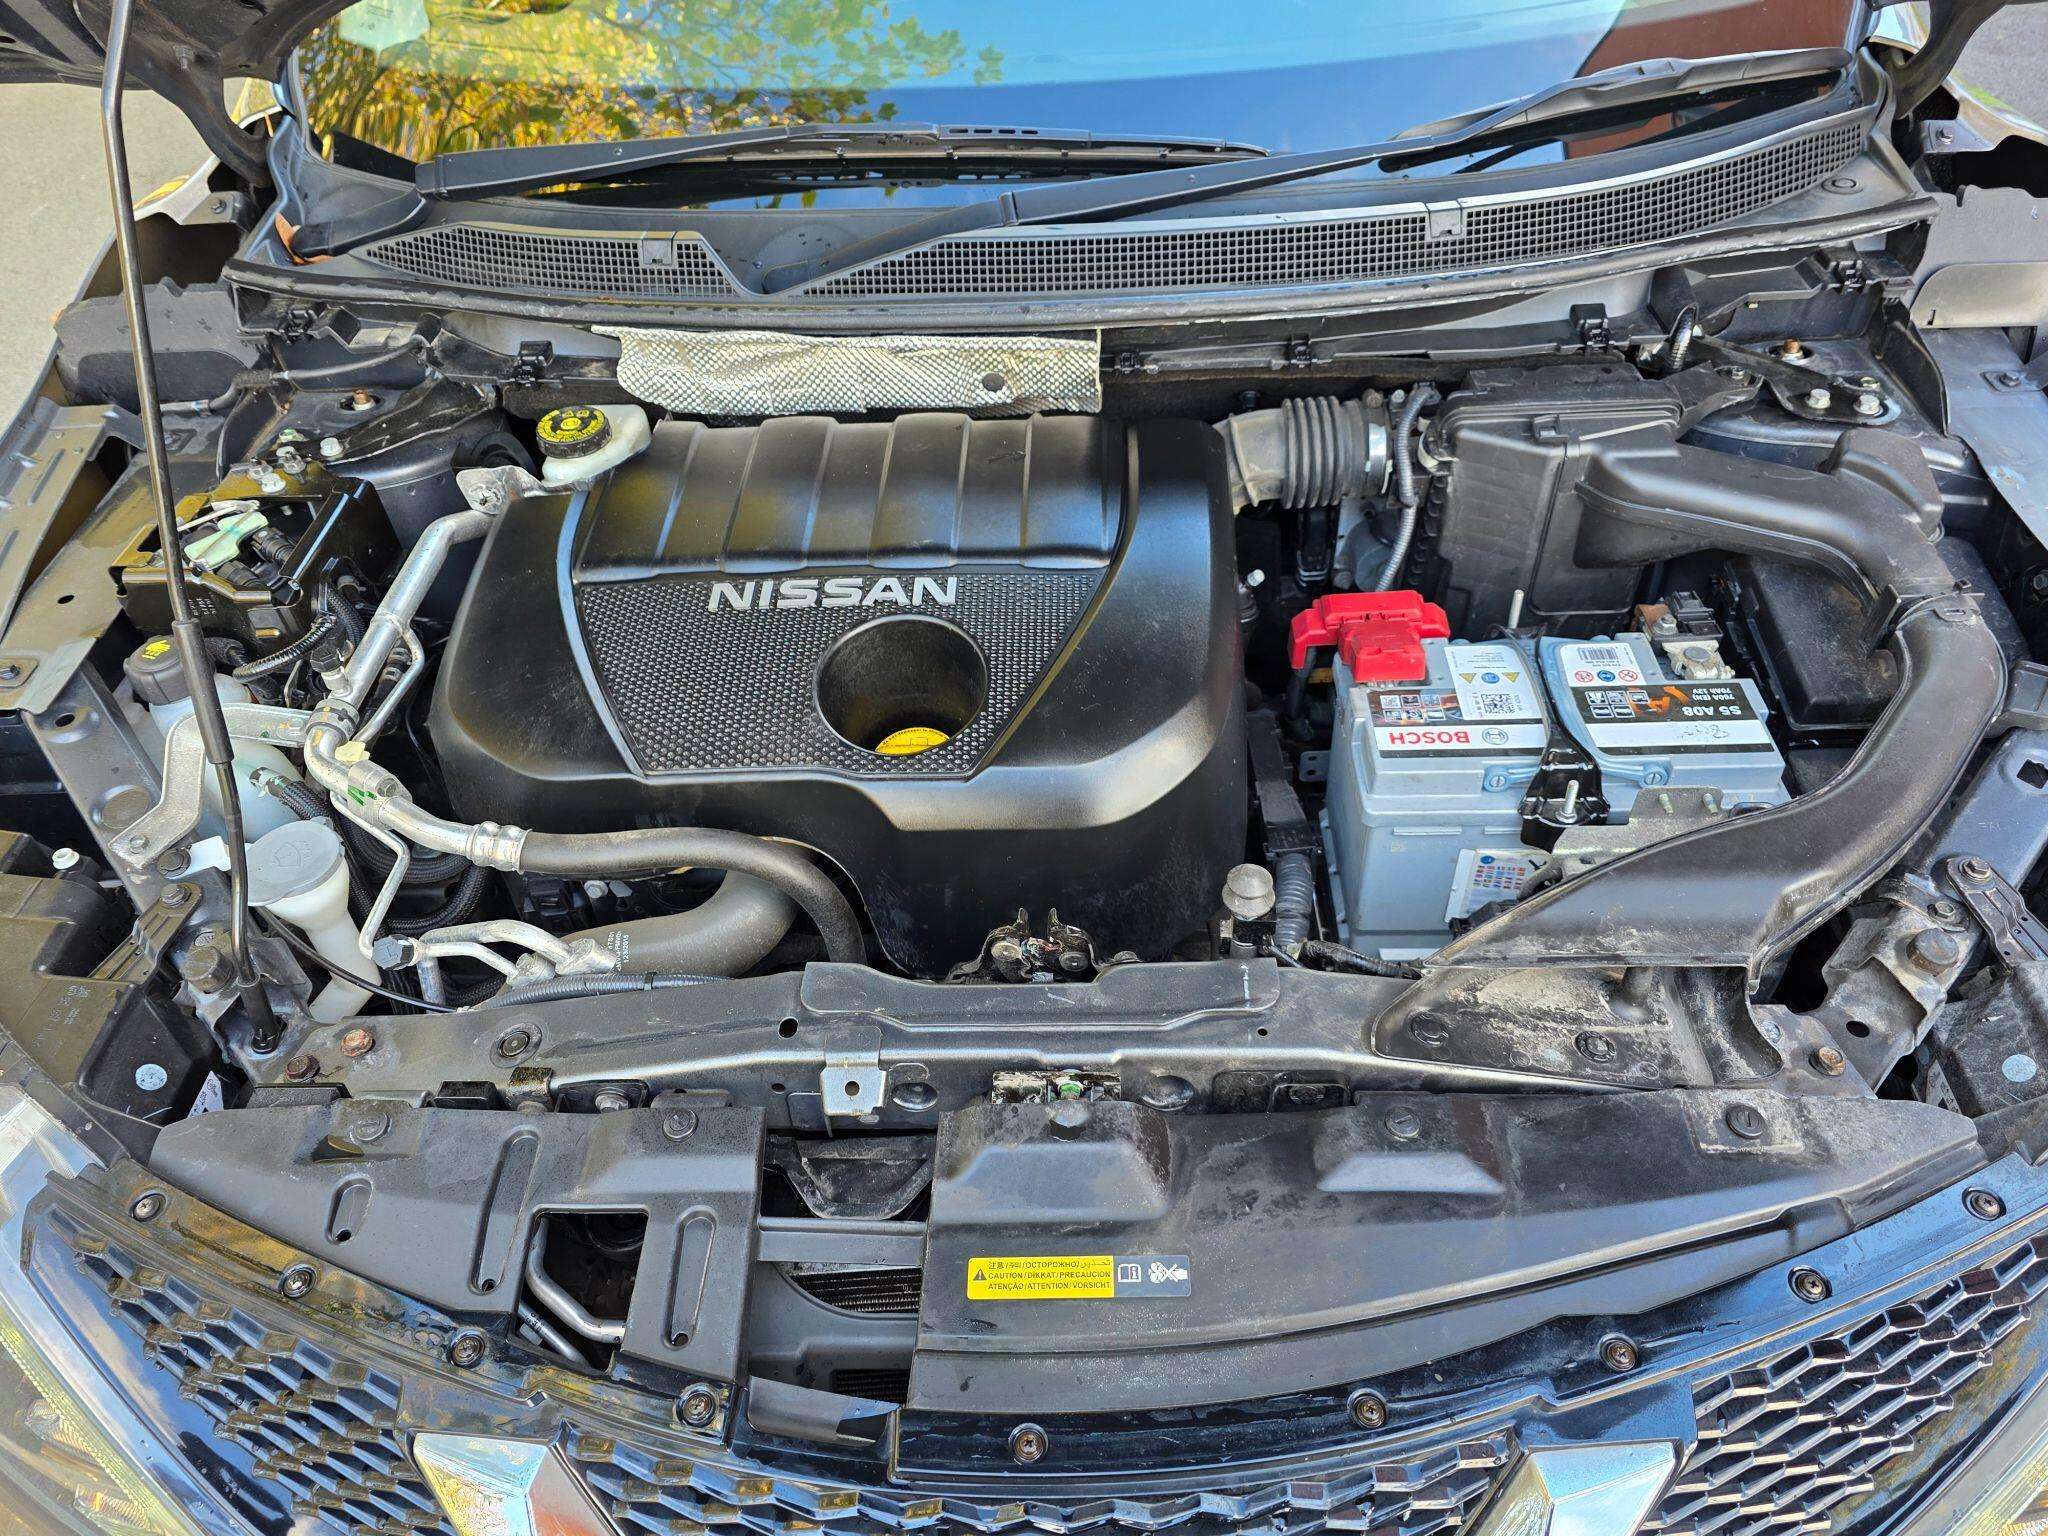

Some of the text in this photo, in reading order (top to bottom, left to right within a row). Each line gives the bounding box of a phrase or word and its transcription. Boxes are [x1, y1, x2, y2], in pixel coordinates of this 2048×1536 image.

[707, 576, 958, 612] NISSAN
[1681, 705, 1742, 716] S5 A08
[1388, 730, 1471, 745] BOSCH
